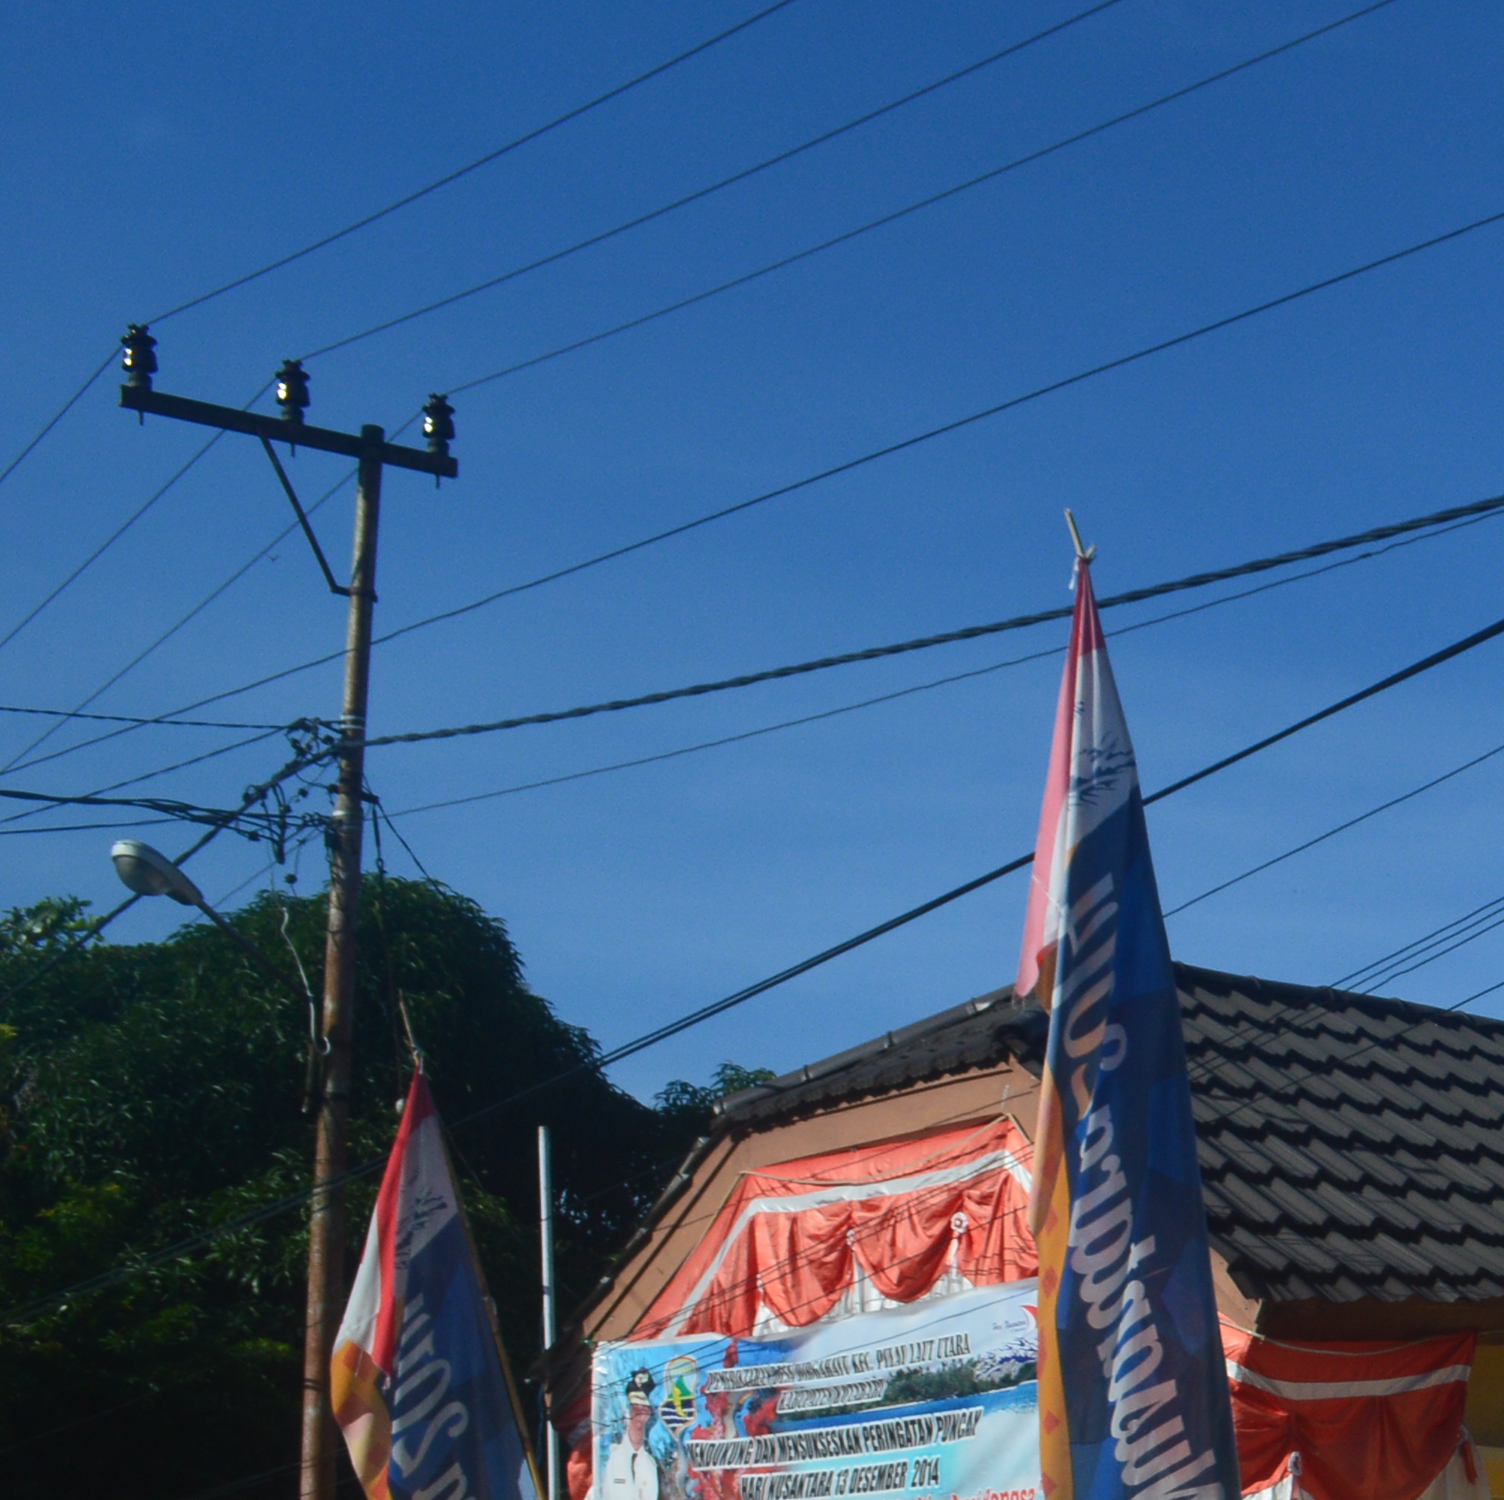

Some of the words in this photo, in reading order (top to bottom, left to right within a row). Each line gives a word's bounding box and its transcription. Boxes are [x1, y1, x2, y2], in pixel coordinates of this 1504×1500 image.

[937, 1333, 971, 1359] UTARA
[754, 1436, 777, 1464] DAN
[778, 1426, 862, 1462] MENSUKSESKAN
[862, 1417, 934, 1453] PERINGATAN
[767, 1470, 834, 1500] NUSANTARA
[835, 1468, 849, 1496] 13
[849, 1461, 908, 1493] DESEMBER
[910, 1457, 940, 1488] 2014
